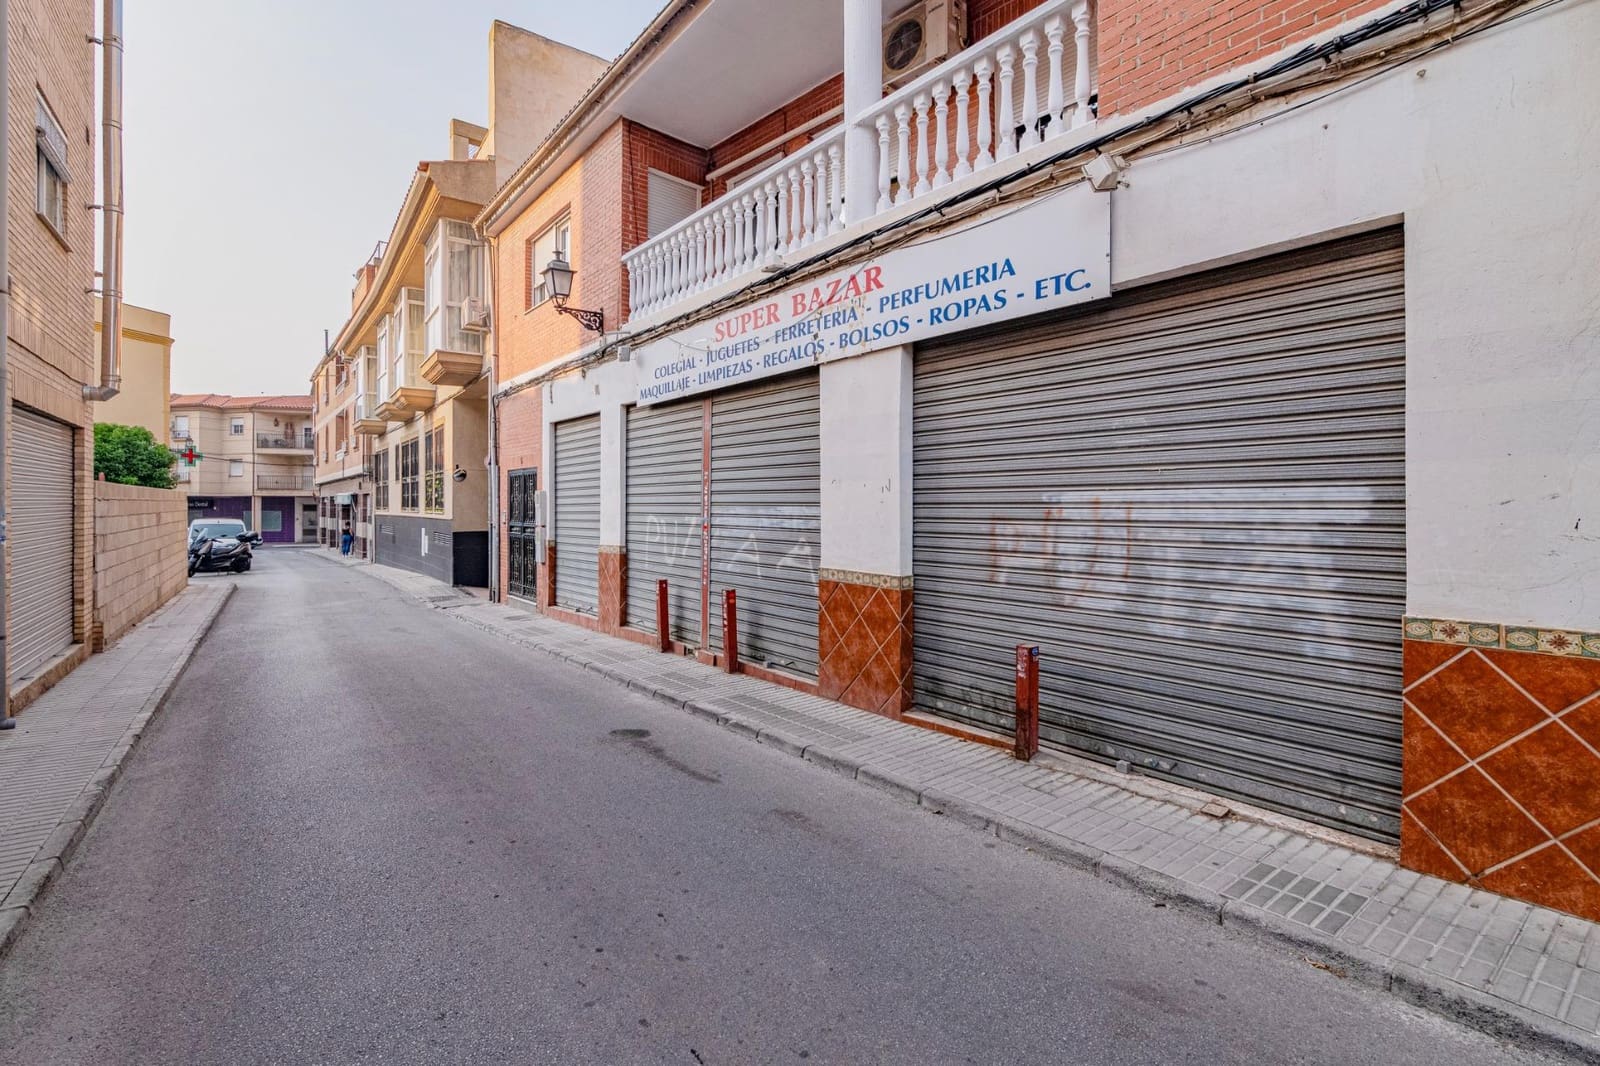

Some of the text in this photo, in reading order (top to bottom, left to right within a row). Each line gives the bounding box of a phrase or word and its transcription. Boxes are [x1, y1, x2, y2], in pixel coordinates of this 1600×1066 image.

[639, 376, 691, 401] MAQUILLAJE
[698, 359, 753, 386] LIMPIEZAS
[763, 338, 825, 369] REGALOS
[839, 315, 910, 350] BOLSOS
[929, 289, 1007, 327] ROPAS
[1034, 268, 1092, 300] ETC.
[654, 356, 697, 380] COLEGIAL
[706, 336, 760, 367] JUGUETES
[774, 306, 858, 345] FERRETERIA
[879, 258, 1017, 313] PERFUMERIA
[714, 265, 885, 343] SUPER BAZAR
